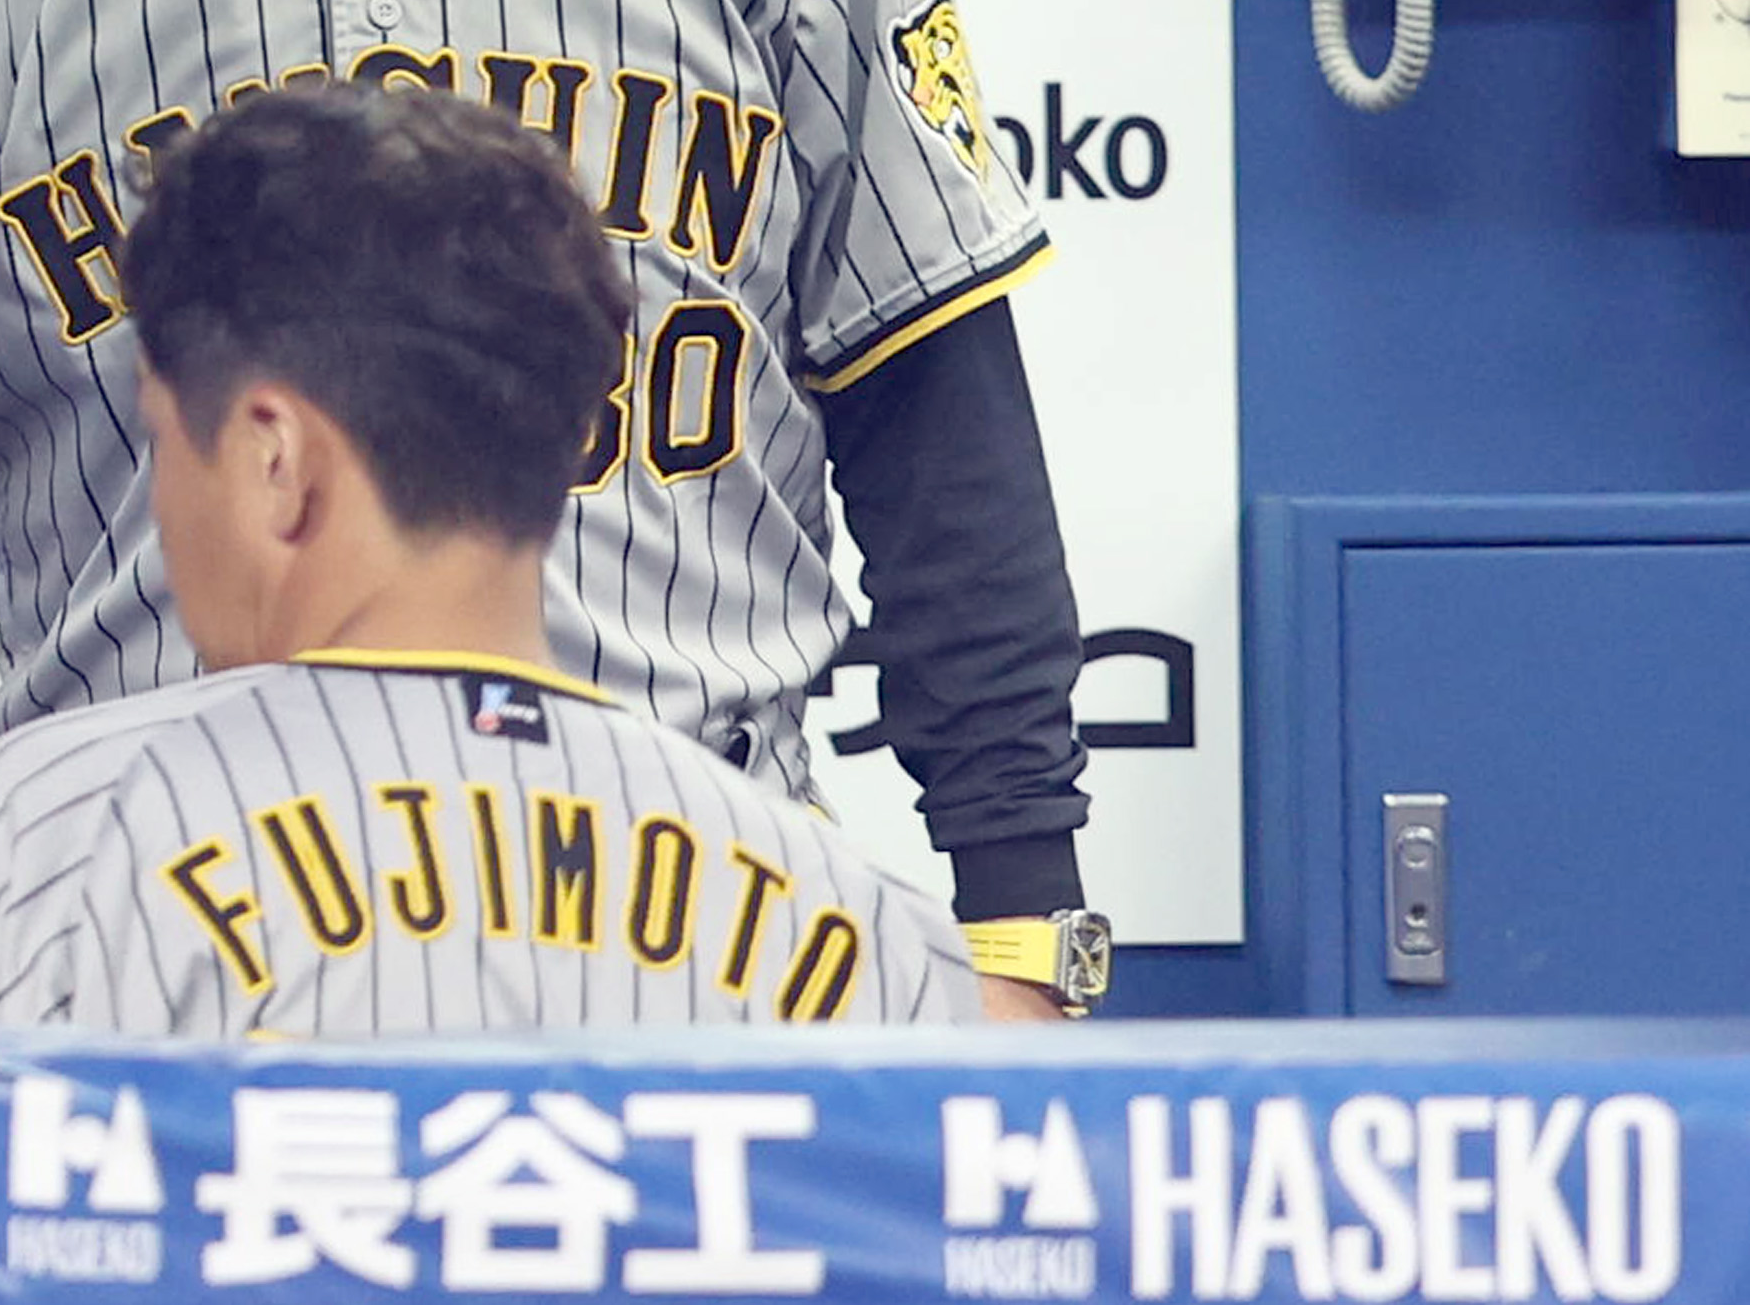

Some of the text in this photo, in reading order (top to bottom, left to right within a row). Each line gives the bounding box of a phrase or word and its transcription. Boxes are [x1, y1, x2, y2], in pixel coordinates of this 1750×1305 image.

[158, 778, 861, 1021] FUJIMOTO
[195, 1087, 827, 1293] 長谷工
[1127, 1093, 1682, 1303] HASEKO
